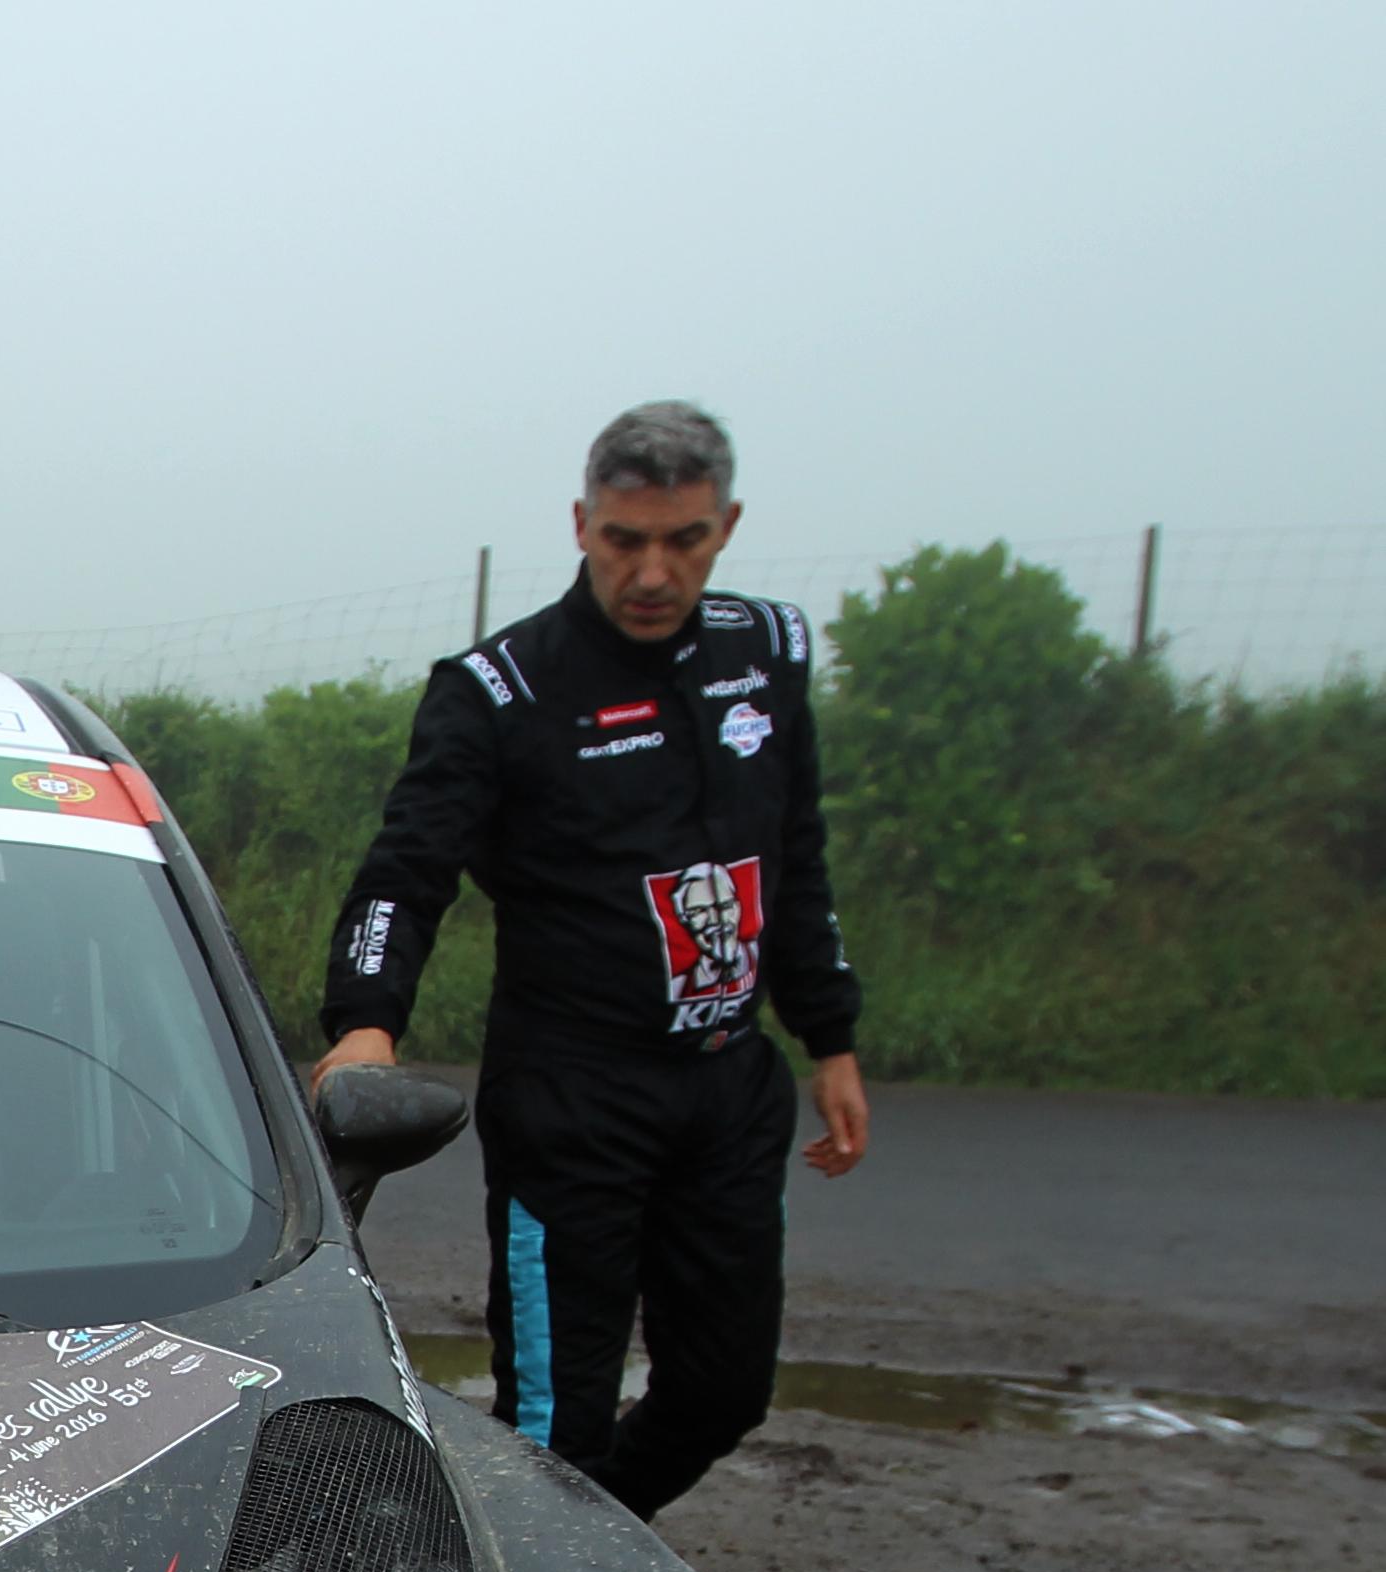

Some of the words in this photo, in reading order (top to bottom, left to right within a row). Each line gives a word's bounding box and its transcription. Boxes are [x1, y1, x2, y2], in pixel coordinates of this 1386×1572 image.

[26, 1375, 109, 1424] rallye
[108, 1377, 152, 1407] 51st
[27, 1434, 61, 1459] June
[55, 1410, 107, 1440] 2016
